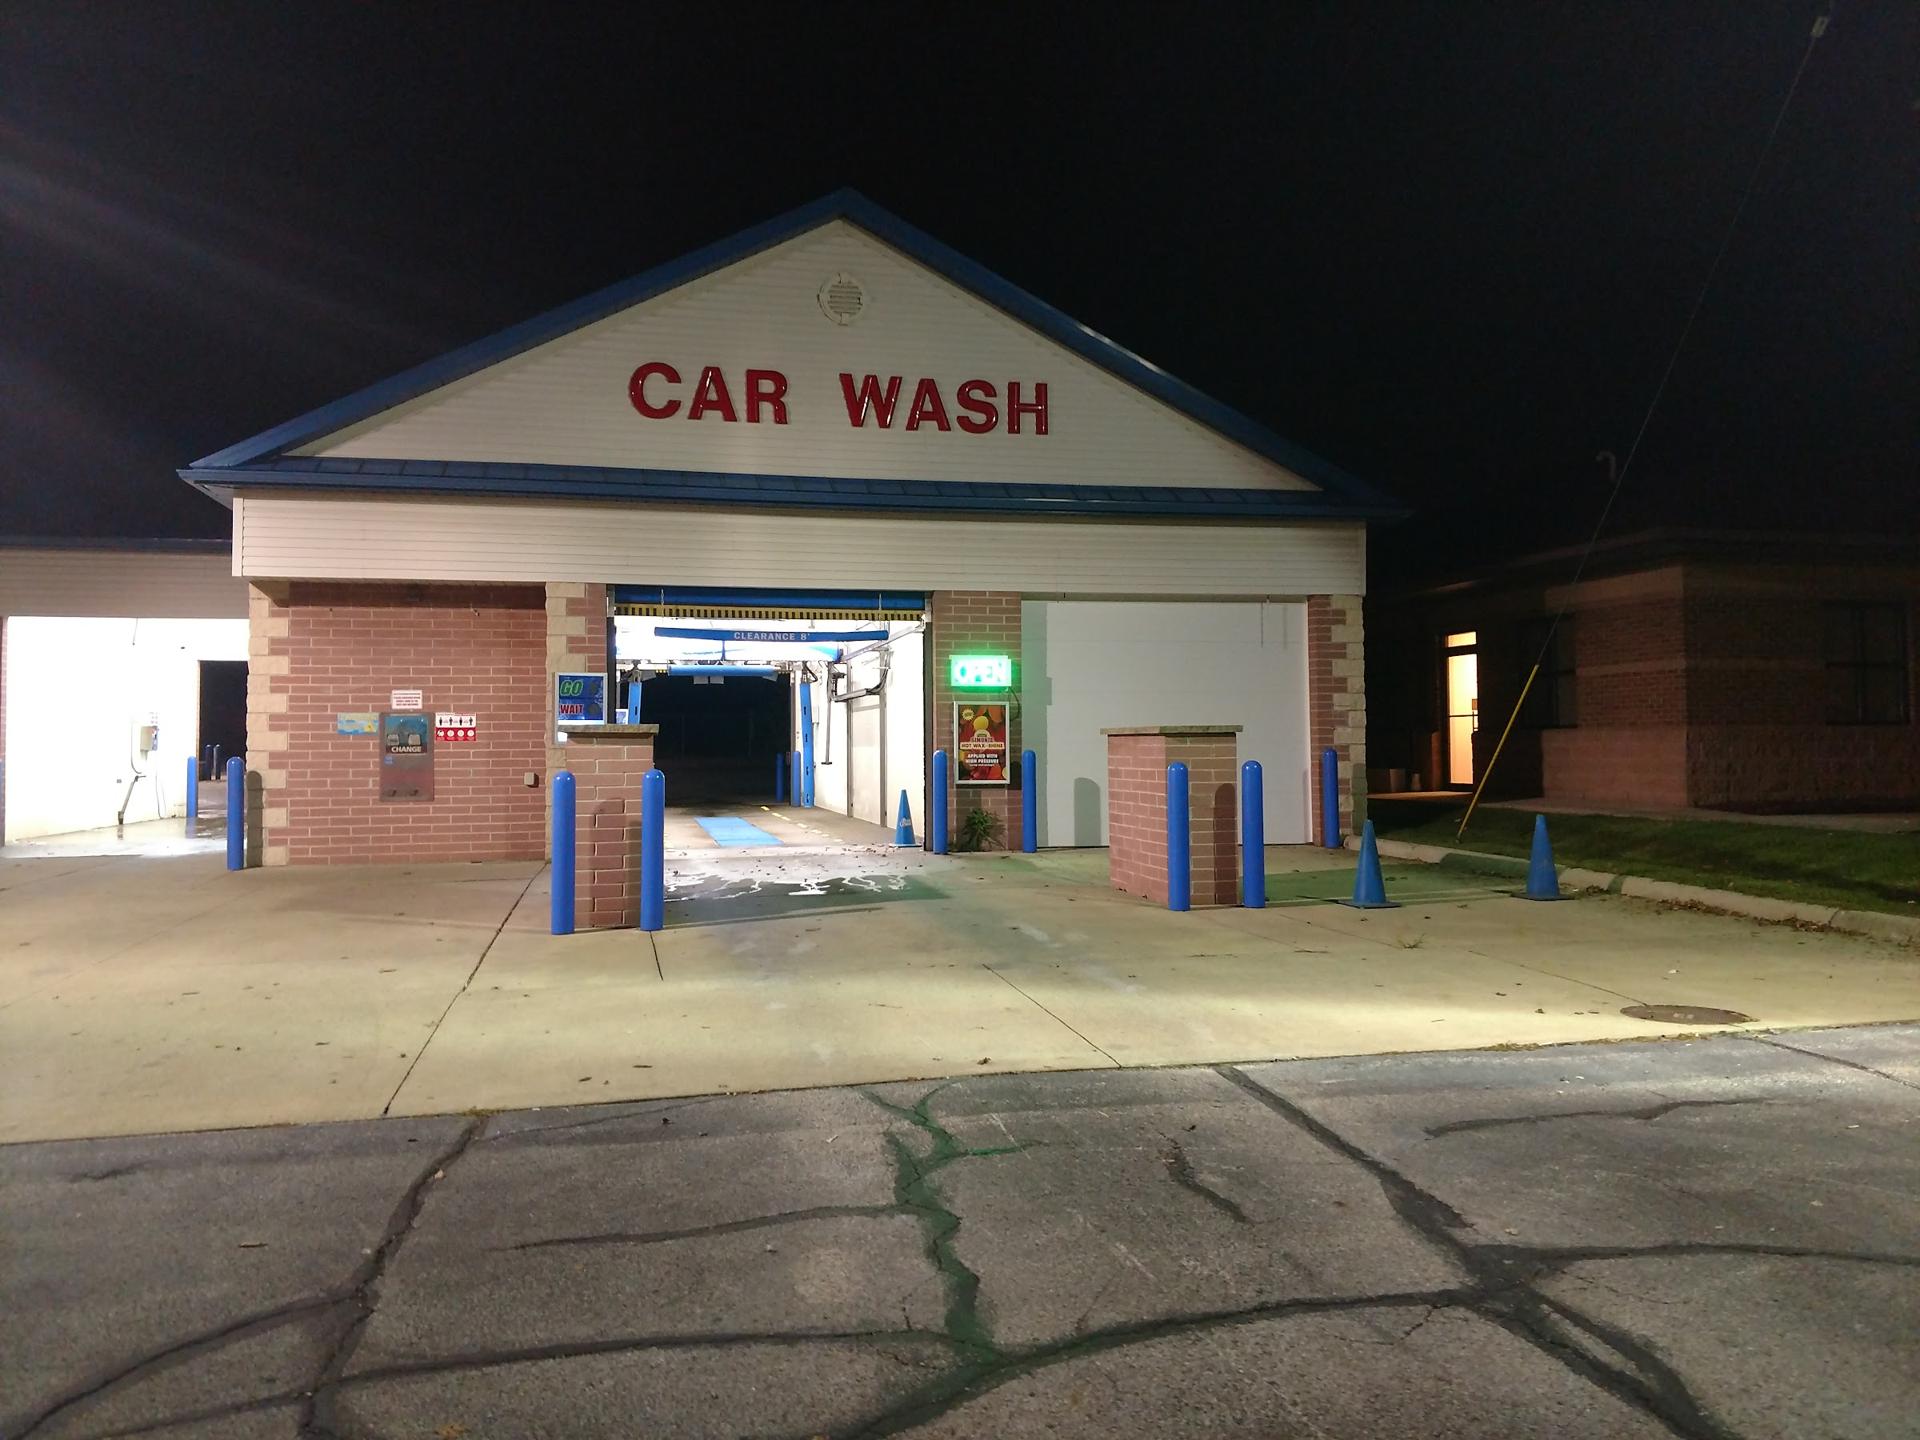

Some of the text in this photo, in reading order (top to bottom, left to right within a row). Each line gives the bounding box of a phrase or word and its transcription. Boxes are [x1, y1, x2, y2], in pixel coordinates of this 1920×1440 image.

[628, 362, 1049, 435] CAR WASH
[733, 631, 810, 641] CLEARANCE 8'
[955, 658, 1009, 685] OPEN
[560, 680, 584, 697] GO
[560, 703, 585, 715] WAIT
[391, 745, 422, 753] CHANGE
